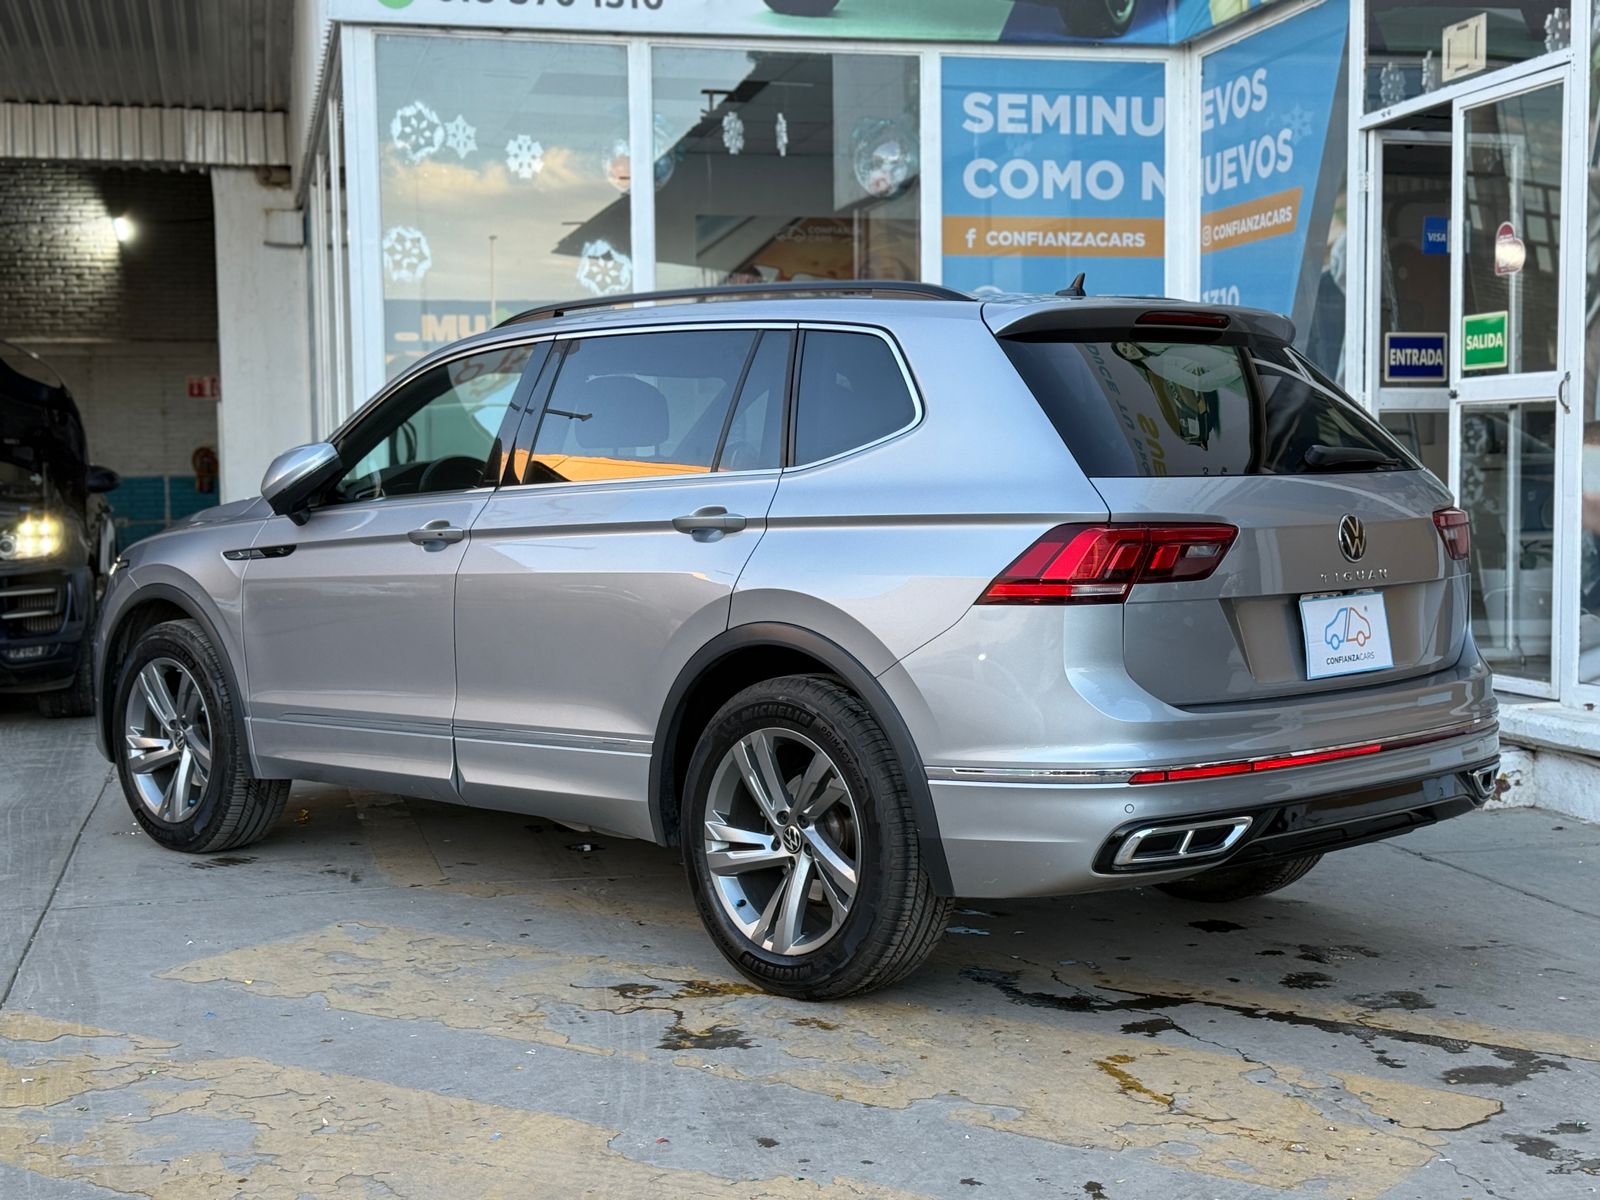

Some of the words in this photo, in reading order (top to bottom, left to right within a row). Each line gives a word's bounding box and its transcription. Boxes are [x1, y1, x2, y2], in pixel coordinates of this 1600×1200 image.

[1201, 67, 1268, 133] EVOS
[962, 92, 1164, 137] SEMINU
[962, 158, 1125, 201] COMO
[1212, 205, 1293, 241] CONFIANZACARS
[985, 231, 1146, 248] CONFIANZACARS
[1427, 232, 1447, 243] VISA
[1465, 332, 1504, 351] SALIDA
[1389, 348, 1444, 366] ENTRADA
[1320, 568, 1388, 584] TIGUAN
[1326, 651, 1375, 666] CONFIANZACARS
[741, 703, 812, 728] MICHELIN
[819, 725, 856, 767] PRIMACY
